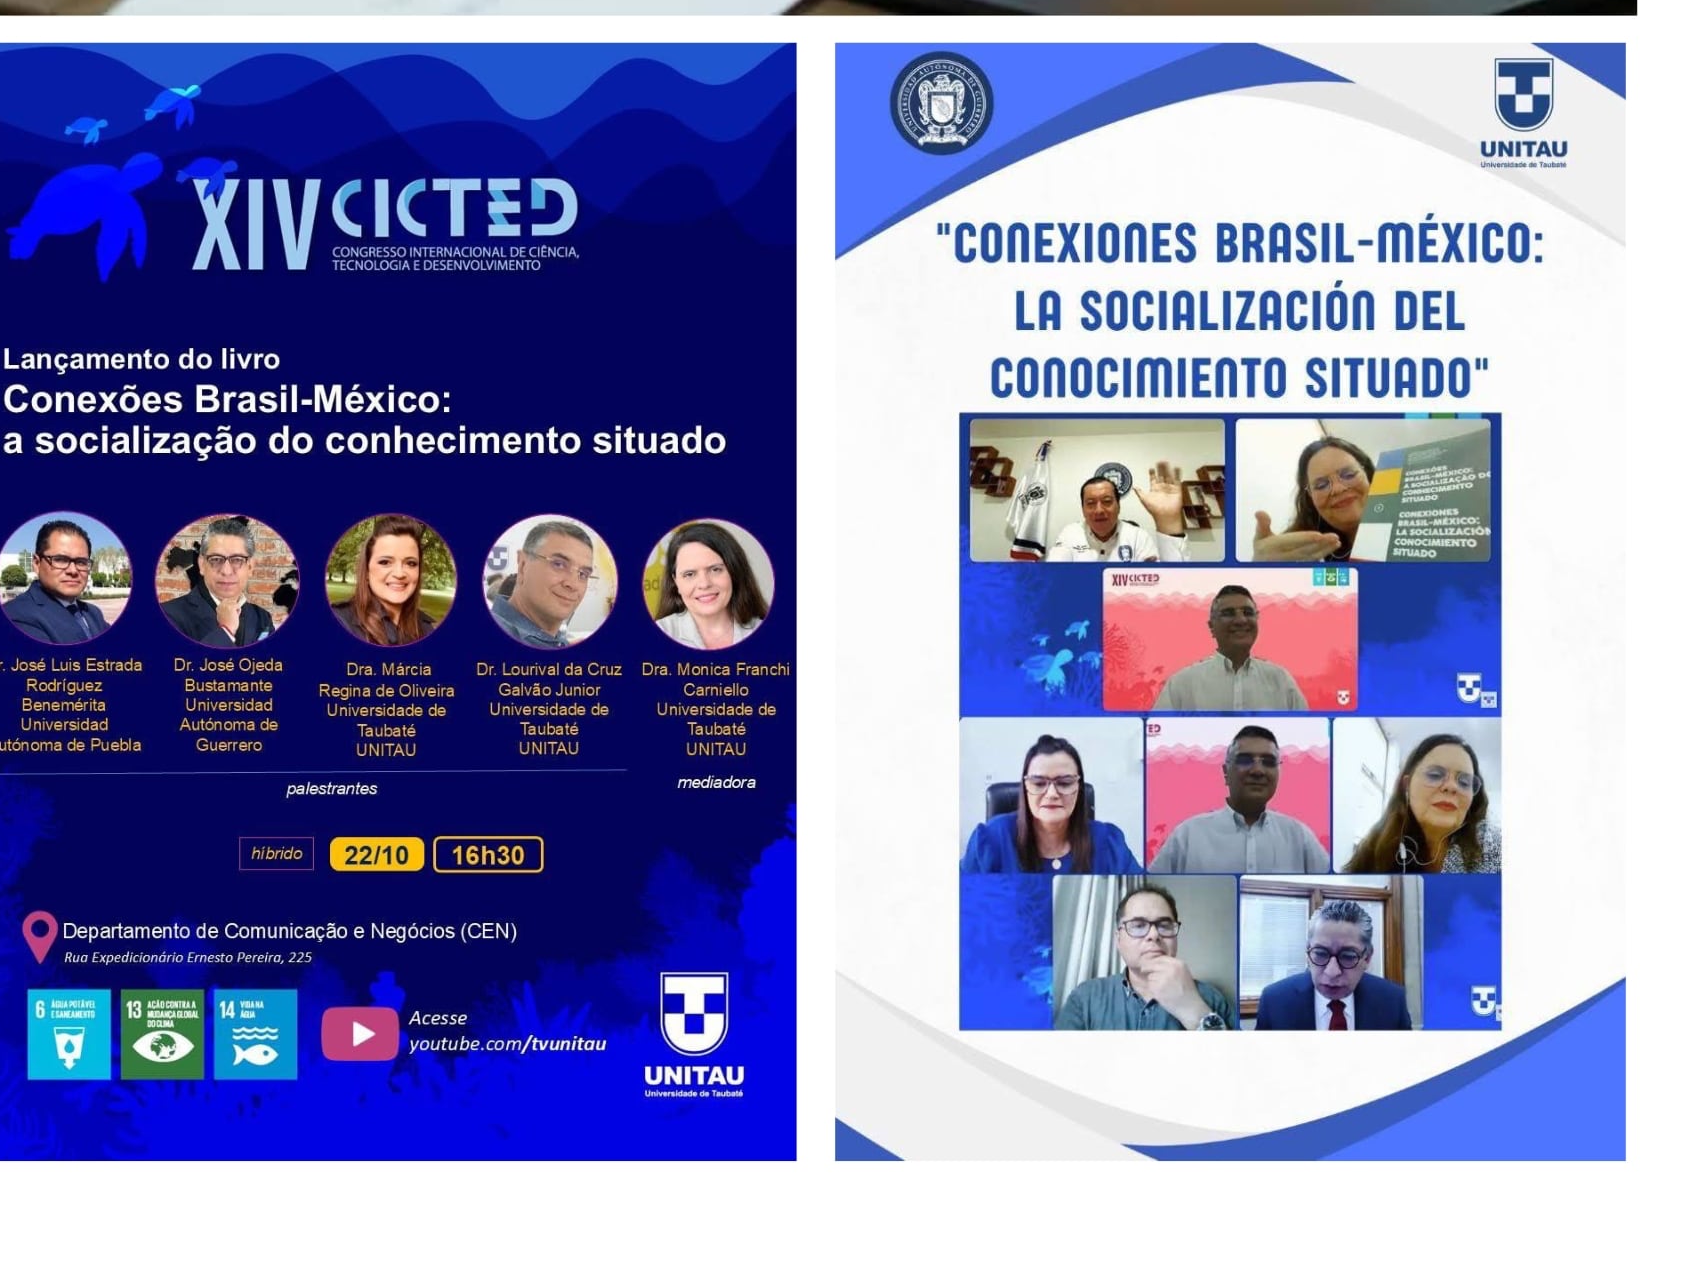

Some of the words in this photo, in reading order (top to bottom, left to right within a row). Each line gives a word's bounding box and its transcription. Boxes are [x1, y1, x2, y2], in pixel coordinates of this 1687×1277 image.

[1480, 140, 1568, 158] UNITAU
[1480, 161, 1527, 169] Universidade
[1528, 161, 1538, 169] de
[1539, 161, 1567, 169] Taubaté
[190, 177, 322, 272] XIV
[331, 177, 579, 238] CICTED
[936, 221, 1197, 264] "CONEXIONES
[1216, 212, 1543, 264] BRASIL-MÉXICO:
[332, 246, 407, 258] CONGRESSO
[409, 246, 507, 258] INTERNACIONAL
[509, 246, 527, 258] DE
[528, 244, 580, 259] CIÊNCIA,
[331, 259, 411, 271] TECNOLOGIA
[413, 259, 421, 271] E
[423, 259, 541, 271] DESENVOLVIMENTO
[1015, 289, 1062, 331] LA
[1080, 279, 1375, 332] SOCIALIZACIÓN
[1395, 290, 1466, 331] DEL
[3, 347, 170, 376] Lançamento
[178, 347, 213, 370] do
[221, 347, 281, 370] livro
[990, 356, 1288, 400] CONOCIMIENTO
[1304, 355, 1490, 399] SITUADO"
[3, 383, 183, 414] Conexões
[195, 383, 450, 414] Brasil-México:
[3, 432, 24, 455] a
[35, 424, 257, 462] socialização
[268, 424, 314, 455] do
[325, 424, 582, 455] conhecimento
[592, 424, 727, 455] situado
[1399, 508, 1460, 519] CONEXIONES
[1397, 516, 1481, 527] BRASIL-MÉXICO:
[1396, 528, 1408, 536] LA
[1394, 538, 1478, 548] CONOCIMIENTO
[1392, 548, 1438, 559] SITUADO
[1111, 573, 1128, 587] XIV
[1129, 573, 1161, 583] CICTED
[10, 657, 47, 672] José
[51, 657, 81, 672] Luis
[86, 657, 143, 672] Estrada
[174, 657, 195, 672] Dr.
[199, 657, 235, 672] José
[238, 657, 283, 675] Ojeda
[346, 662, 377, 676] Dra.
[382, 662, 432, 676] Márcia
[476, 662, 497, 676] Dr.
[502, 662, 560, 677] Lourival
[564, 661, 583, 676] da
[587, 662, 623, 676] Cruz
[642, 661, 672, 676] Dra.
[677, 662, 731, 676] Monica
[736, 662, 790, 676] Franchi
[26, 678, 103, 696] Rodríguez
[185, 678, 273, 692] Bustamante
[319, 683, 371, 701] Regina
[375, 683, 395, 698] de
[398, 683, 455, 698] Oliveira
[498, 682, 552, 697] Galvão
[555, 682, 602, 697] Junior
[683, 682, 749, 697] Carniello
[22, 697, 106, 712] Benemérita
[185, 697, 273, 712] Universidad
[327, 702, 424, 717] Universidade
[427, 702, 447, 717] de
[489, 701, 587, 716] Universidade
[590, 702, 610, 716] de
[657, 701, 754, 716] Universidade
[758, 701, 777, 716] de
[21, 717, 109, 732] Universidad
[179, 717, 256, 732] Autónoma
[259, 717, 279, 732] de
[356, 723, 417, 738] Taubaté
[519, 721, 579, 736] Taubaté
[686, 721, 747, 736] Taubaté
[66, 737, 86, 752] de
[90, 737, 142, 752] Puebla
[195, 737, 263, 752] Guerrero
[356, 742, 417, 757] UNITAU
[519, 741, 579, 756] UNITAU
[686, 741, 747, 756] UNITAU
[677, 774, 757, 789] mediadora
[285, 781, 378, 799] palestrantes
[251, 845, 304, 860] híbrido
[344, 845, 409, 866] 22/10
[452, 845, 525, 866] 16h30
[63, 922, 191, 944] Departamento
[195, 922, 219, 939] de
[224, 922, 348, 943] Comunicação
[353, 925, 365, 939] e
[371, 922, 456, 944] Negócios
[460, 922, 517, 944] (CEN)
[64, 951, 89, 963] Rua
[91, 950, 184, 966] Expedicionário
[186, 951, 234, 964] Ernesto
[236, 951, 285, 965] Pereira,
[287, 951, 313, 964] 225
[35, 1000, 45, 1019] 6
[126, 1000, 142, 1019] 13
[219, 1000, 236, 1020] 14
[408, 1010, 468, 1026] Acesse
[408, 1031, 607, 1055] youtube.com/tvunitau
[644, 1064, 745, 1087] UNITAU
[644, 1089, 697, 1098] Universidade
[698, 1089, 710, 1098] de
[711, 1088, 744, 1098] Taubaté
